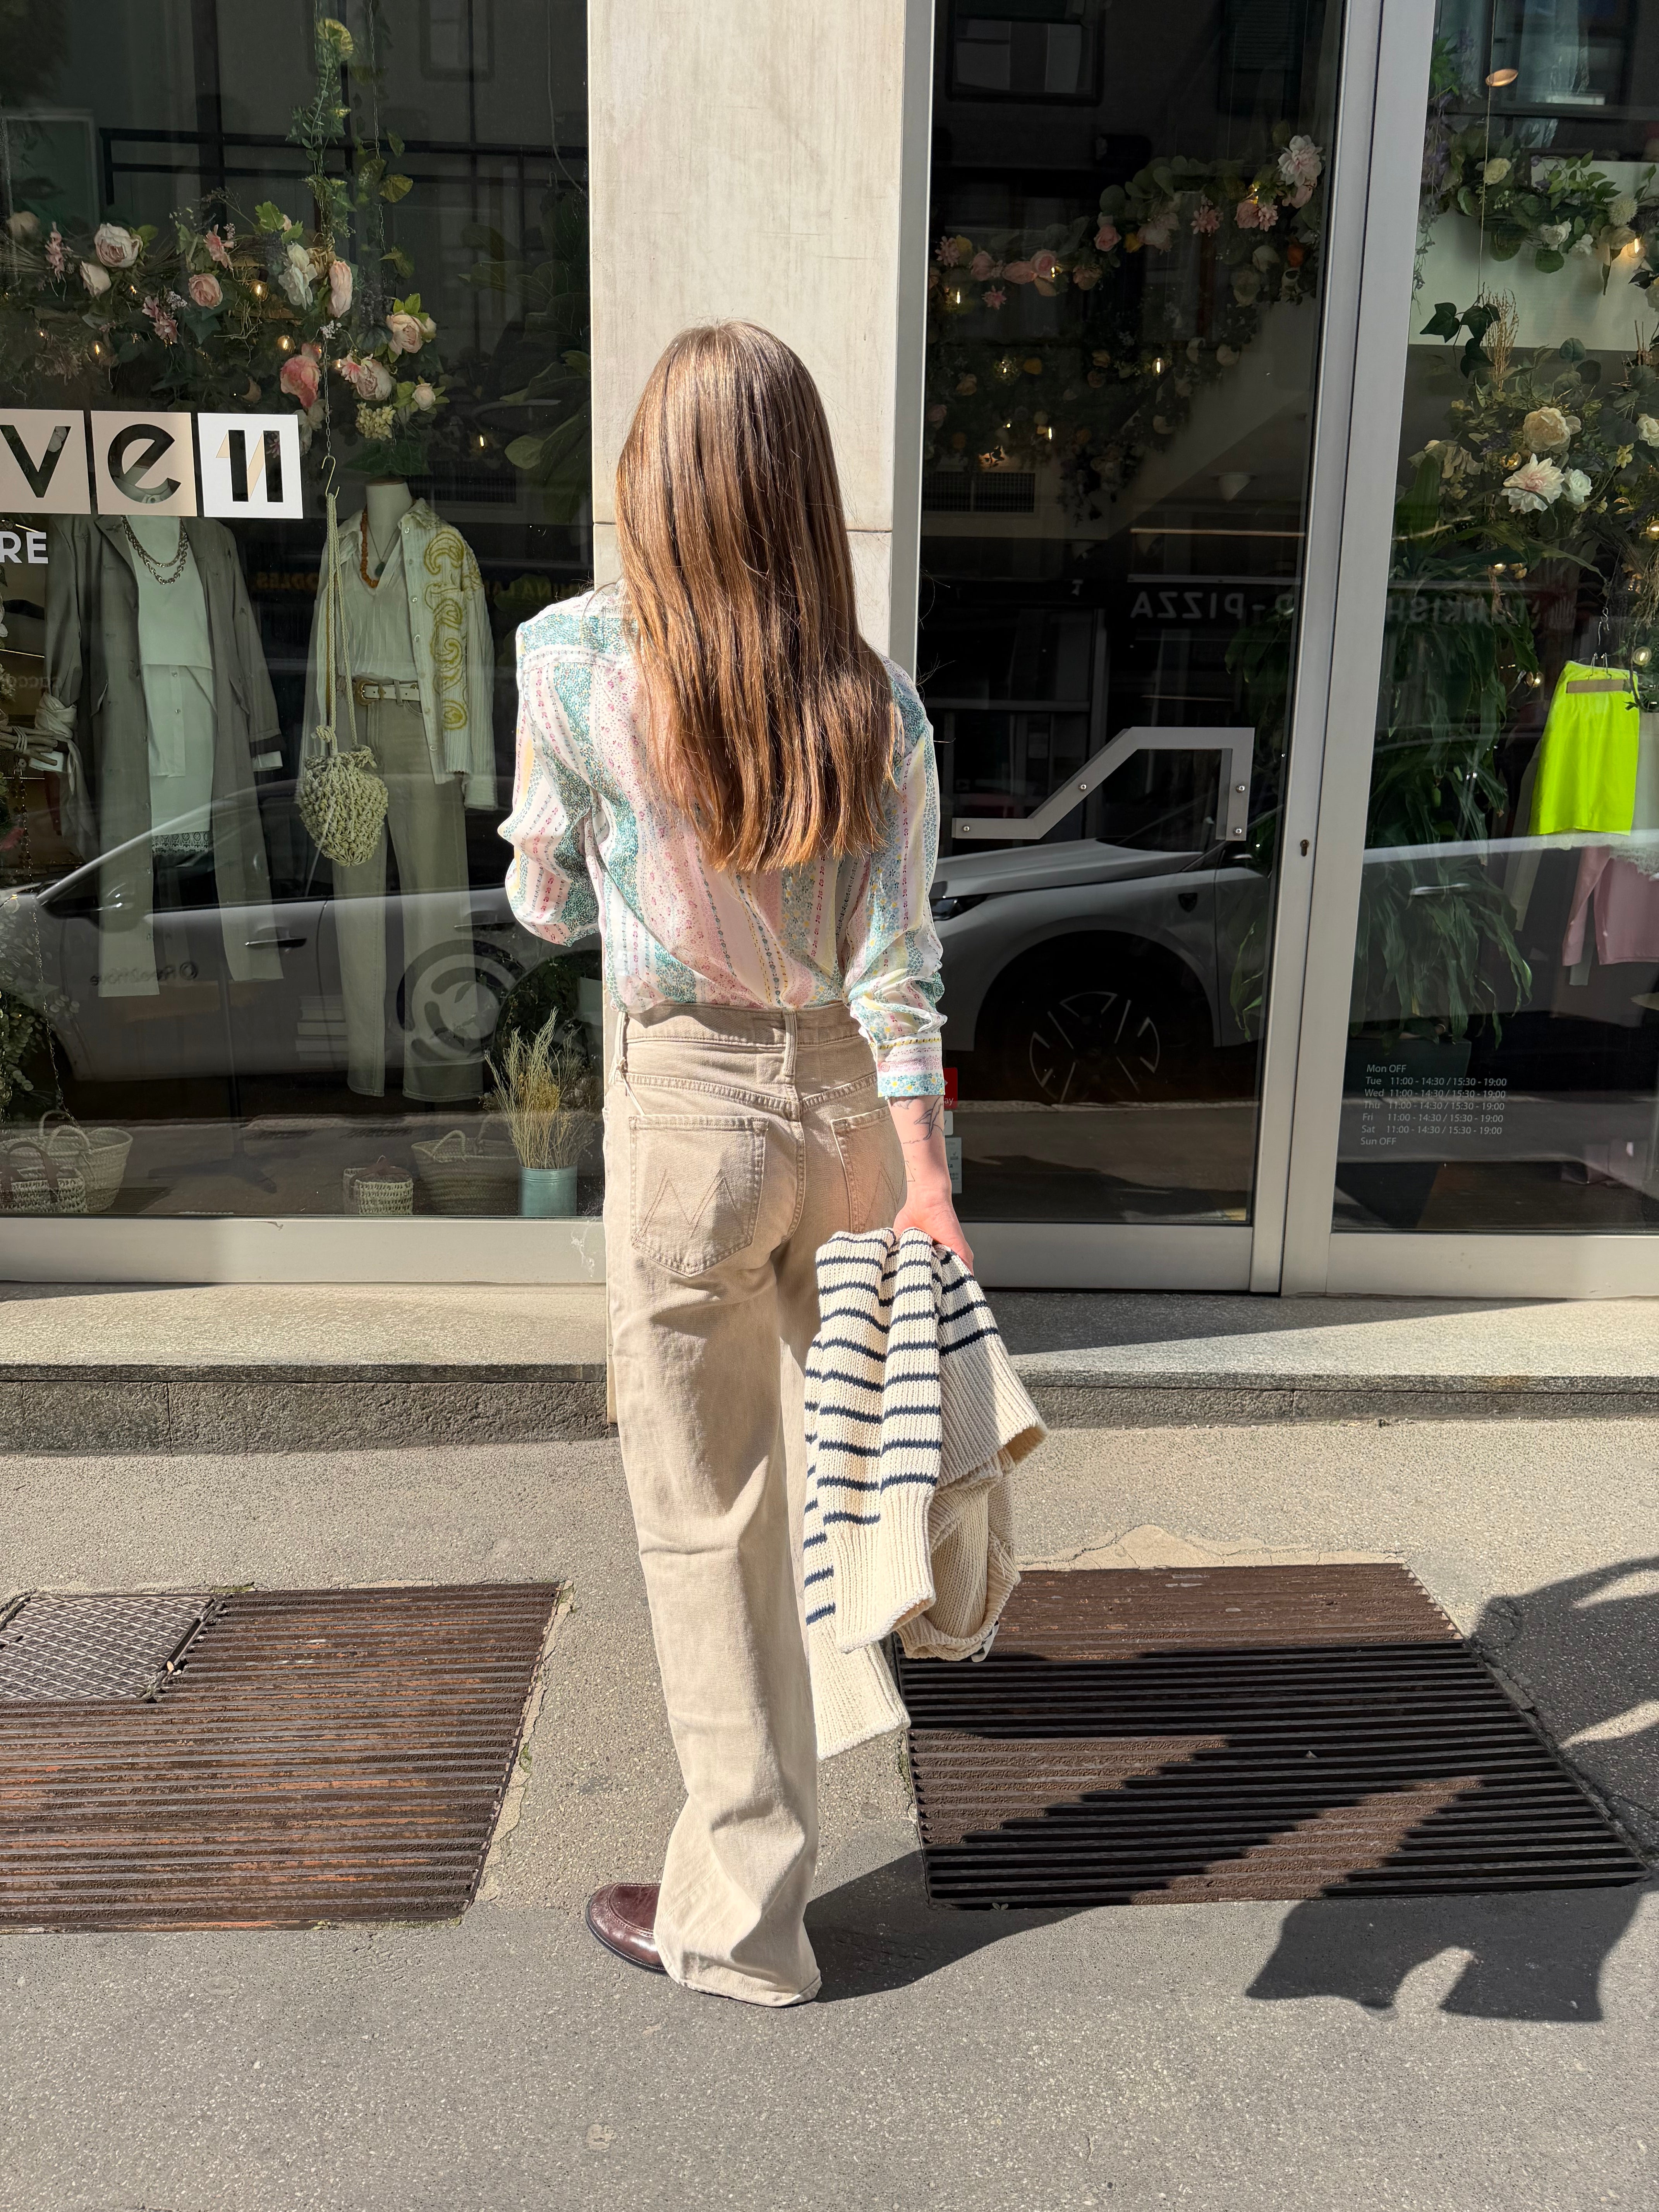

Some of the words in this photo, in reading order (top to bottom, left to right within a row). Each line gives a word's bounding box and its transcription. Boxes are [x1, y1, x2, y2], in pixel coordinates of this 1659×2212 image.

[1367, 1064, 1386, 1073] Mon
[1389, 1065, 1407, 1073] OFF
[1365, 1076, 1382, 1085] Tue
[1484, 1078, 1507, 1086] 19:00
[1365, 1089, 1384, 1097] Wed
[1483, 1090, 1506, 1098] 19:00
[1364, 1100, 1380, 1109] Thu
